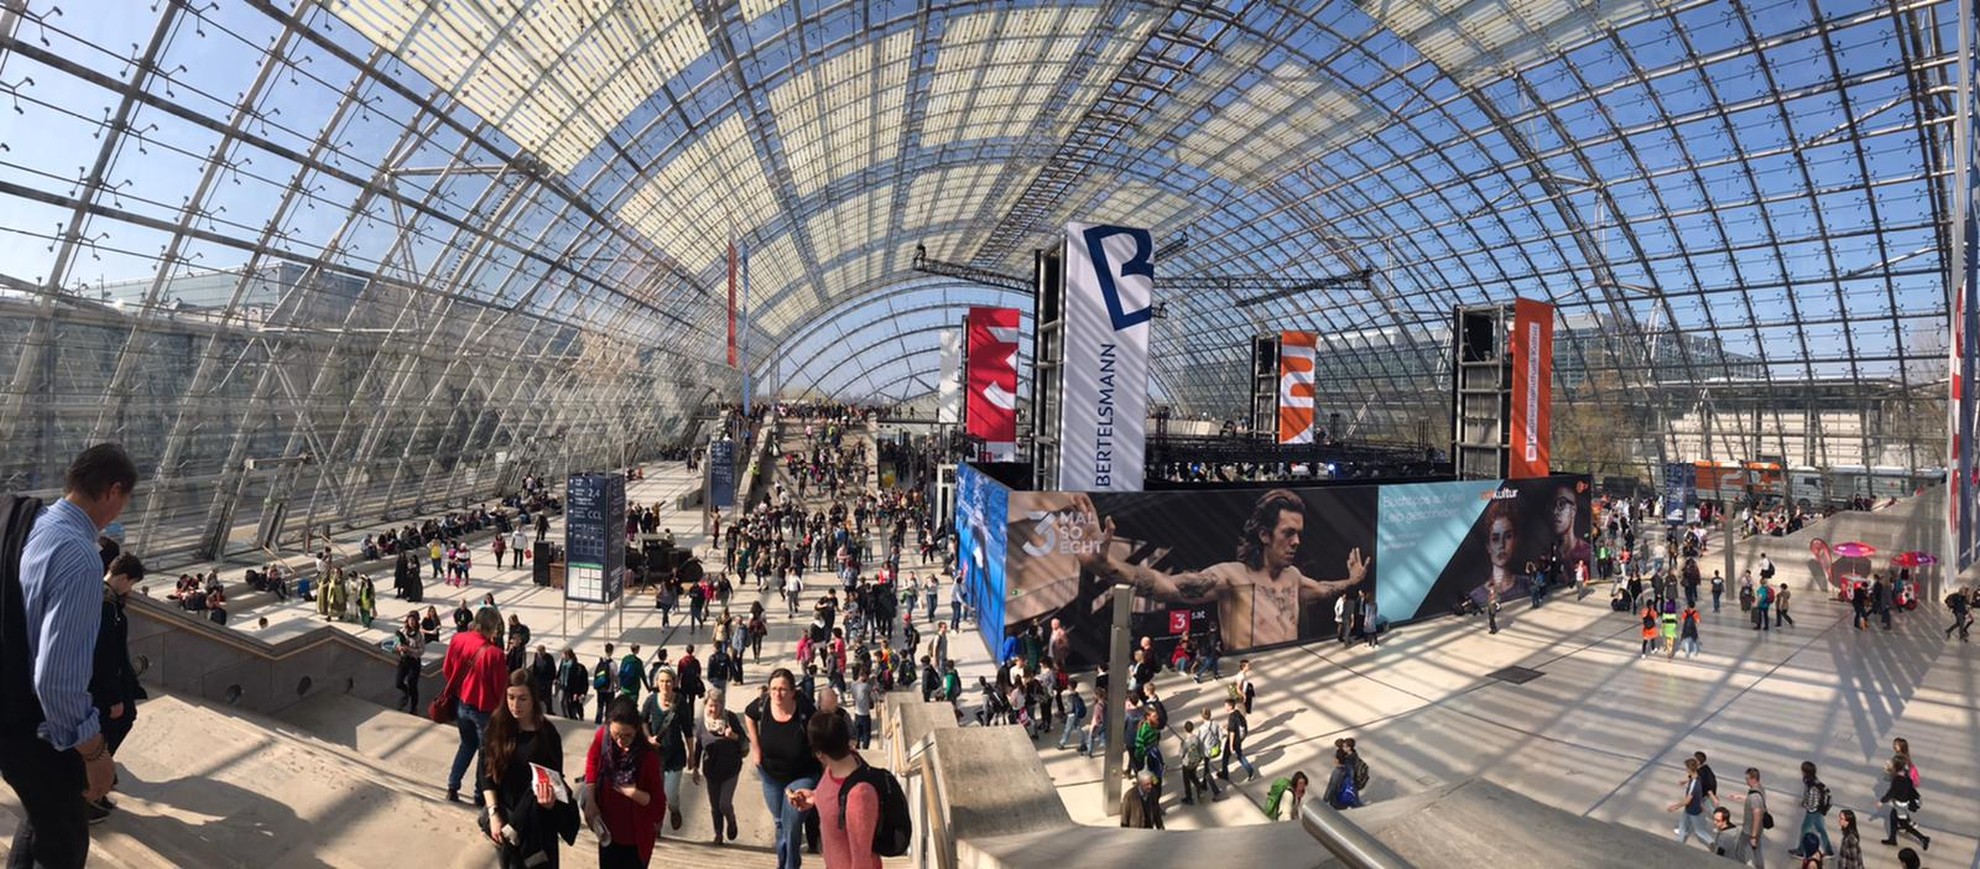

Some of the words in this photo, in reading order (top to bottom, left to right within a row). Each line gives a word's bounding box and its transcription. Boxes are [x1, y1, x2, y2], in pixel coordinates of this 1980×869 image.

[1096, 343, 1116, 487] BERTELSMANN
[1060, 511, 1096, 525] MAL
[1022, 511, 1056, 557] 3
[1060, 526, 1083, 540] SO
[1060, 540, 1101, 554] ECHT
[1174, 613, 1186, 629] 3
